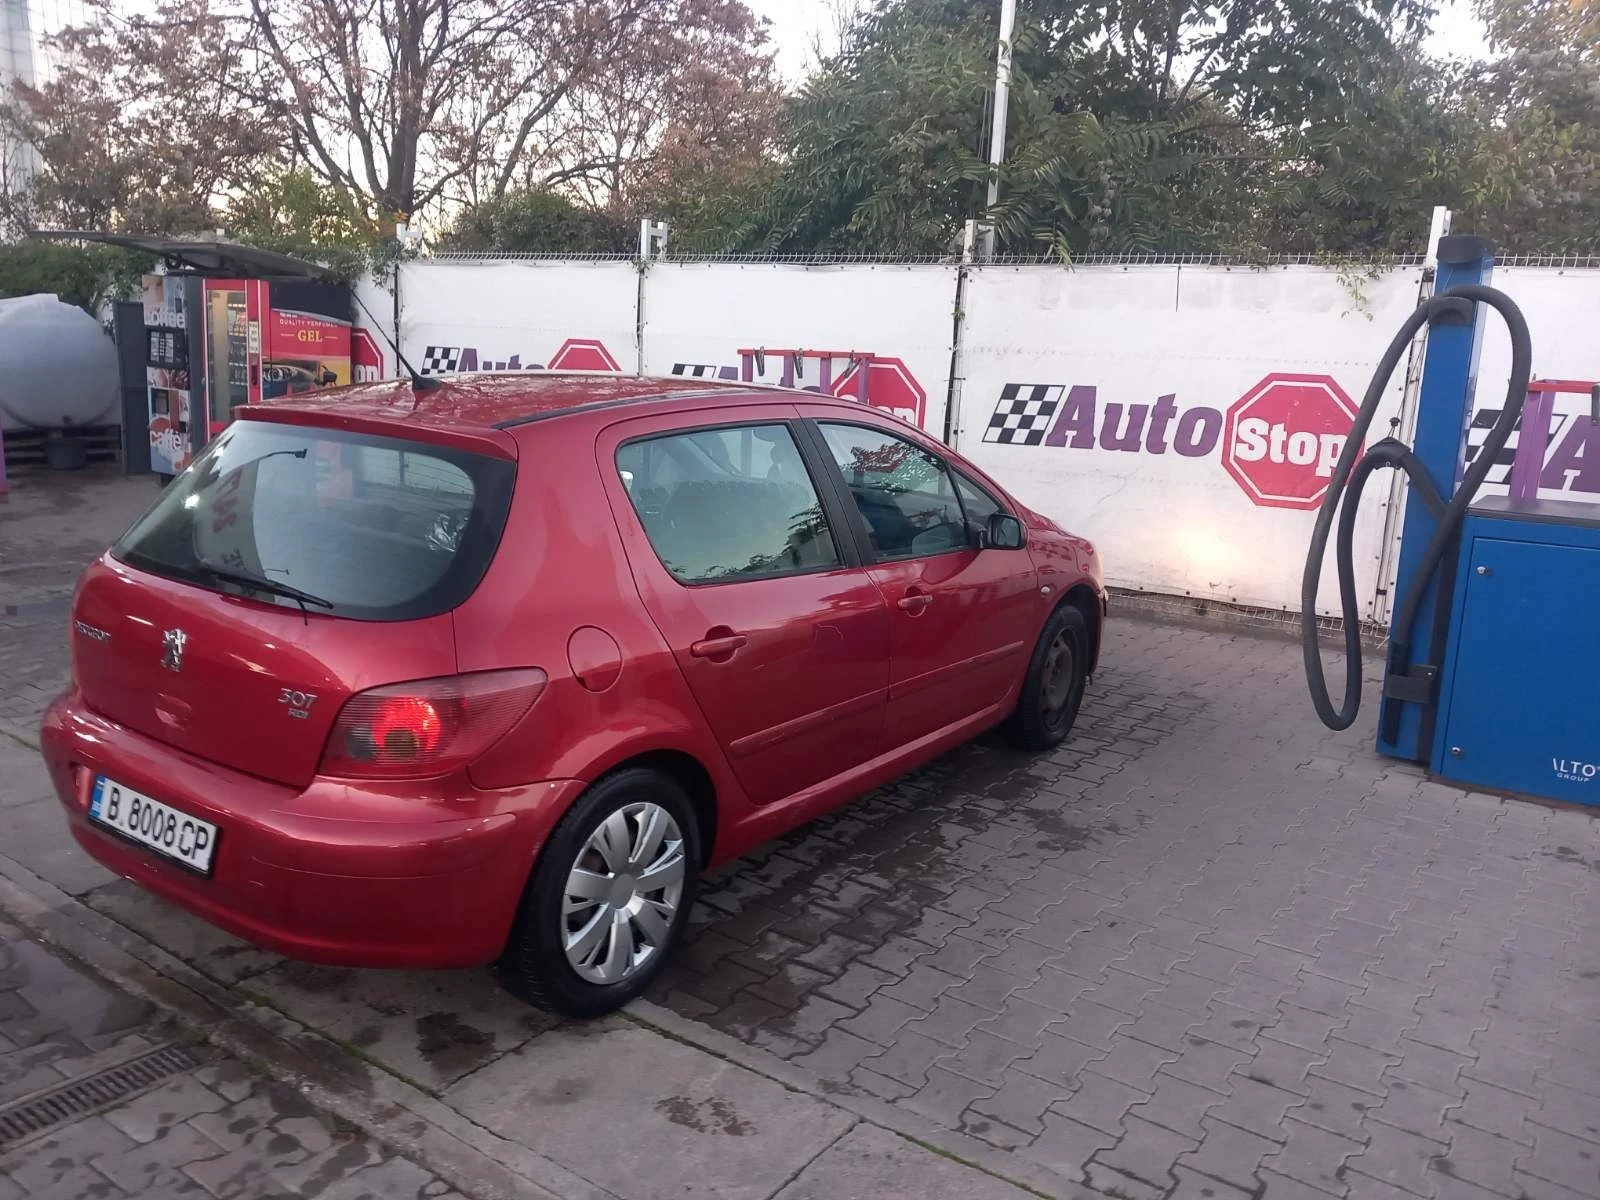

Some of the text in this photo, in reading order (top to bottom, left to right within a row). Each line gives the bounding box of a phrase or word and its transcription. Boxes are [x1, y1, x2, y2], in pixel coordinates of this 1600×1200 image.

[297, 329, 323, 343] GEL
[1045, 385, 1349, 478] Auto Stop
[276, 687, 319, 709] 307
[108, 786, 120, 820] B
